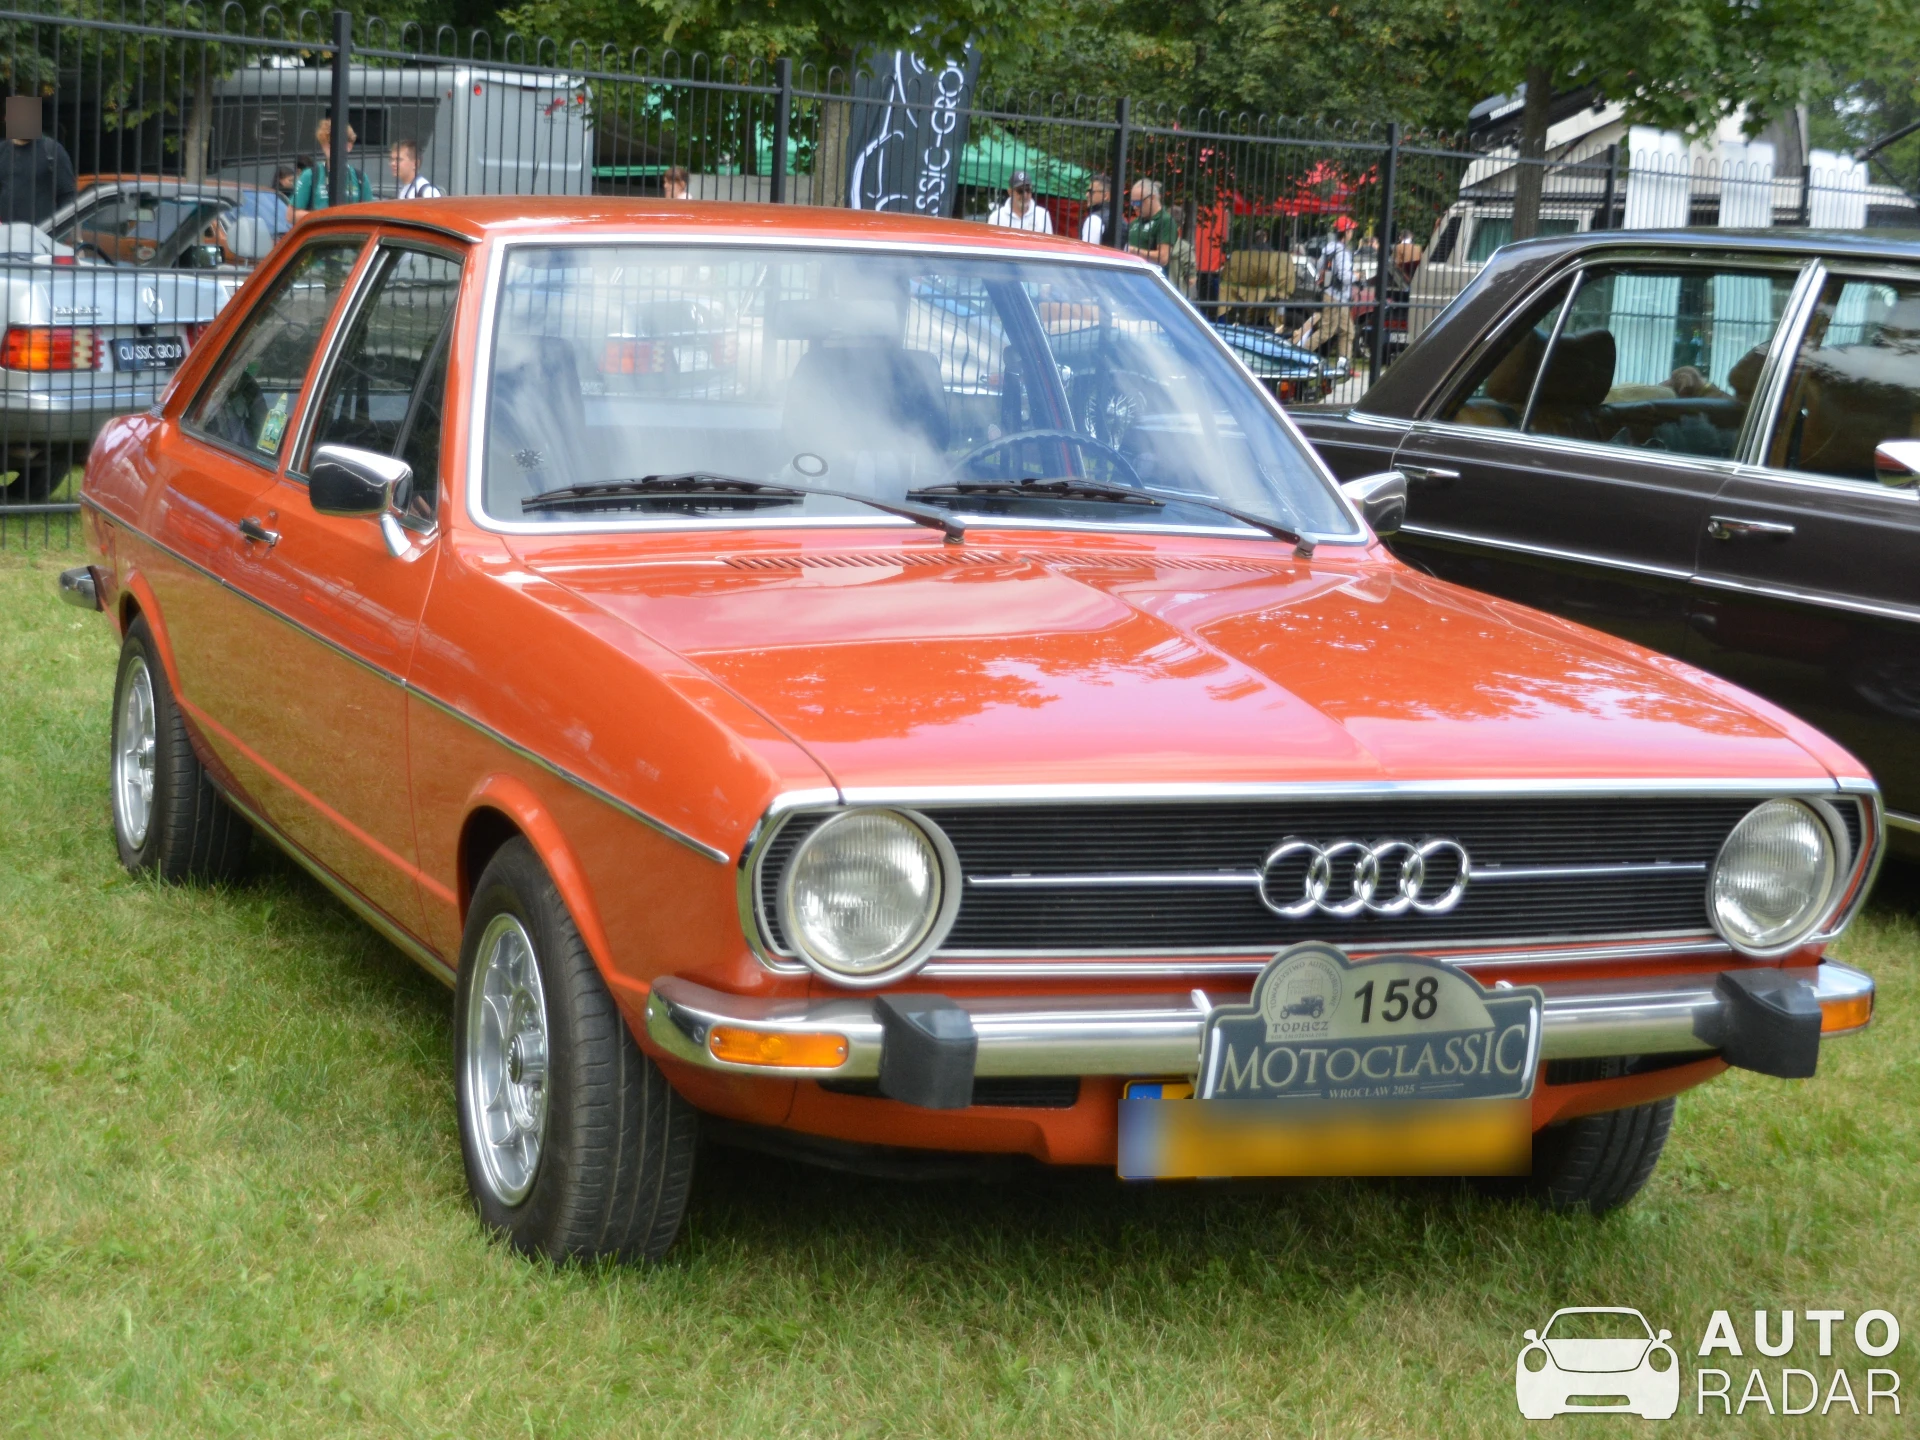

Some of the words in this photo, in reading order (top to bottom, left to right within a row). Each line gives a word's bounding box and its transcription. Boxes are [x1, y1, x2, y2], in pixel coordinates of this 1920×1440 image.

[915, 60, 965, 216] SSIC-GRO
[1354, 976, 1439, 1024] 158
[1272, 1021, 1329, 1033] TOPACZ
[1216, 1023, 1525, 1092] MOTOCLASSIC
[1392, 1083, 1415, 1095] 2025
